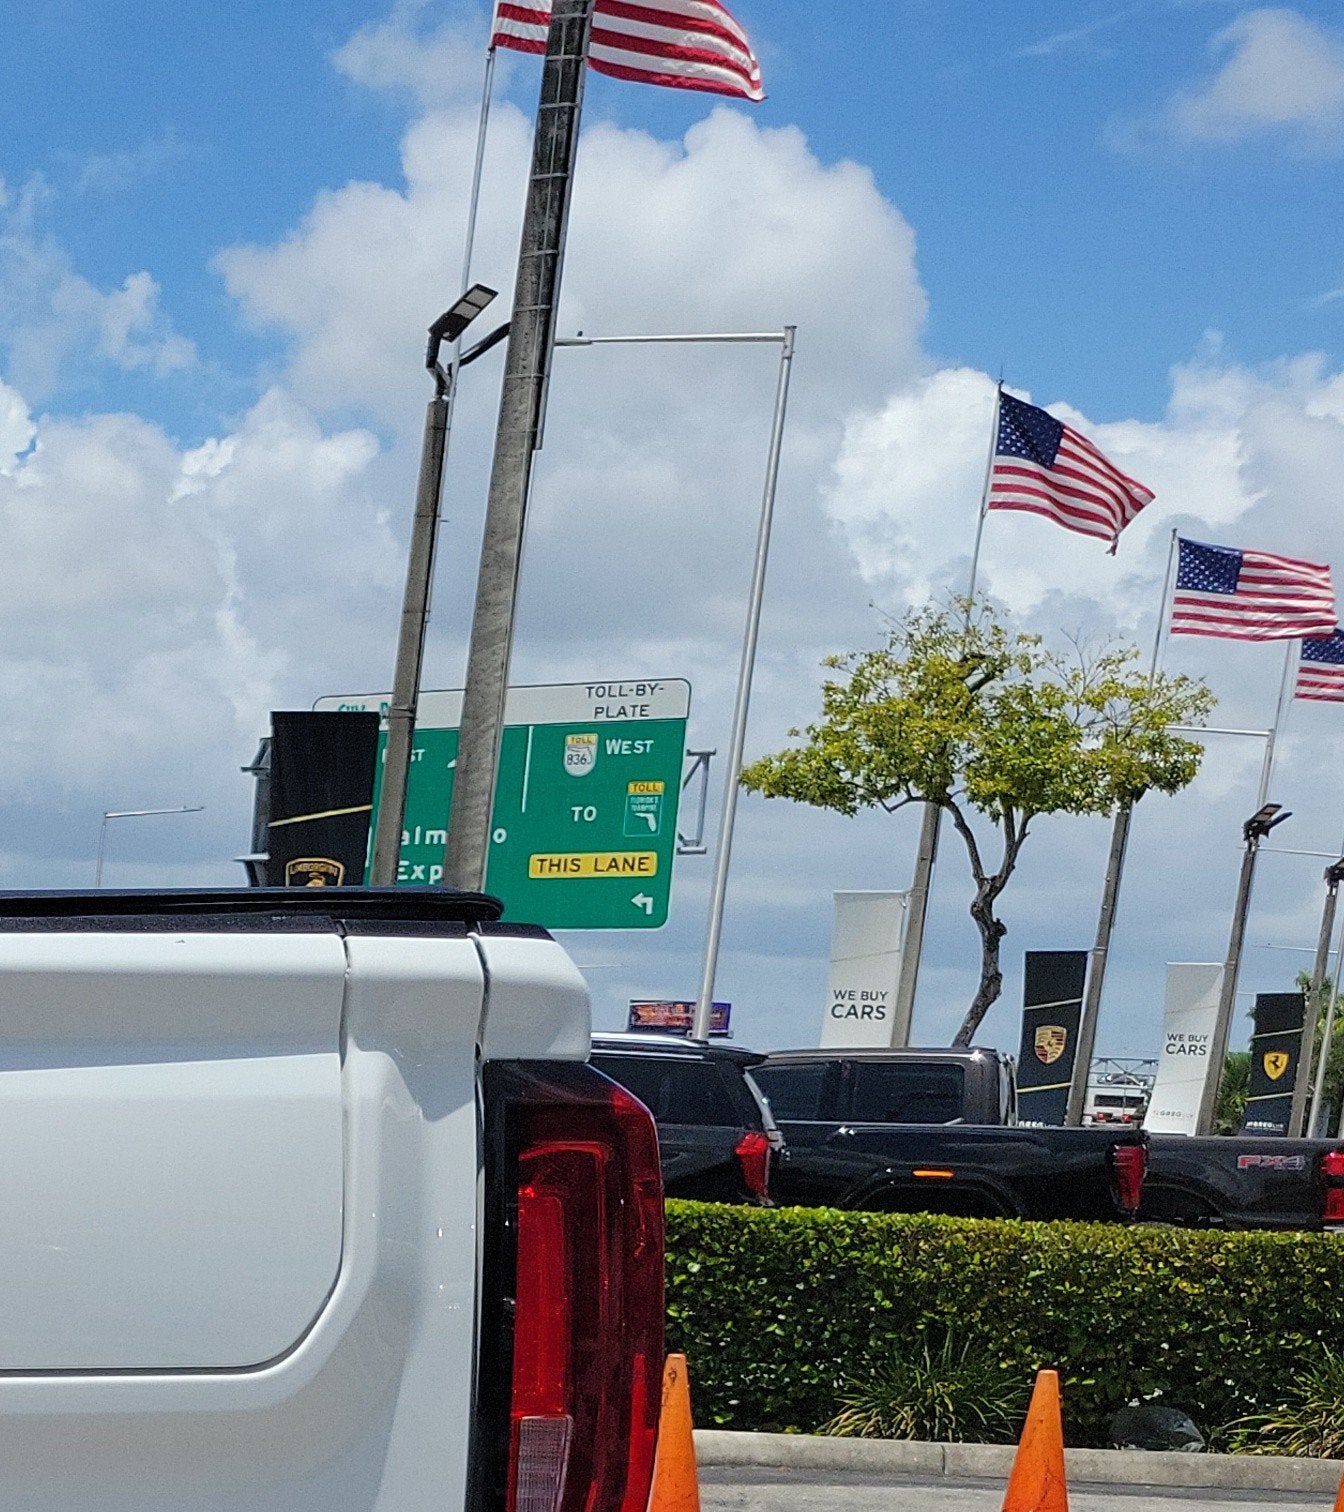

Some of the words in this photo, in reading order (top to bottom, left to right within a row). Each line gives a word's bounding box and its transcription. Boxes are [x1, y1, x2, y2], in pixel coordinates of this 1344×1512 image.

[585, 684, 665, 700] TOLL-BY-
[593, 704, 650, 719] PLATE
[571, 736, 593, 744] TOLL
[605, 738, 655, 755] WEST
[566, 753, 588, 766] 836
[633, 782, 660, 793] TOLL
[570, 805, 598, 823] TO
[536, 857, 582, 874] THIS
[593, 855, 651, 873] LANE
[397, 860, 443, 885] Exp
[832, 988, 857, 1002] WE
[860, 989, 889, 1003] BUY
[830, 1003, 888, 1021] CARS
[1166, 1032, 1185, 1043] WE
[1187, 1032, 1209, 1044] BUY
[1164, 1042, 1208, 1057] CARS
[1237, 1153, 1306, 1172] FX4
